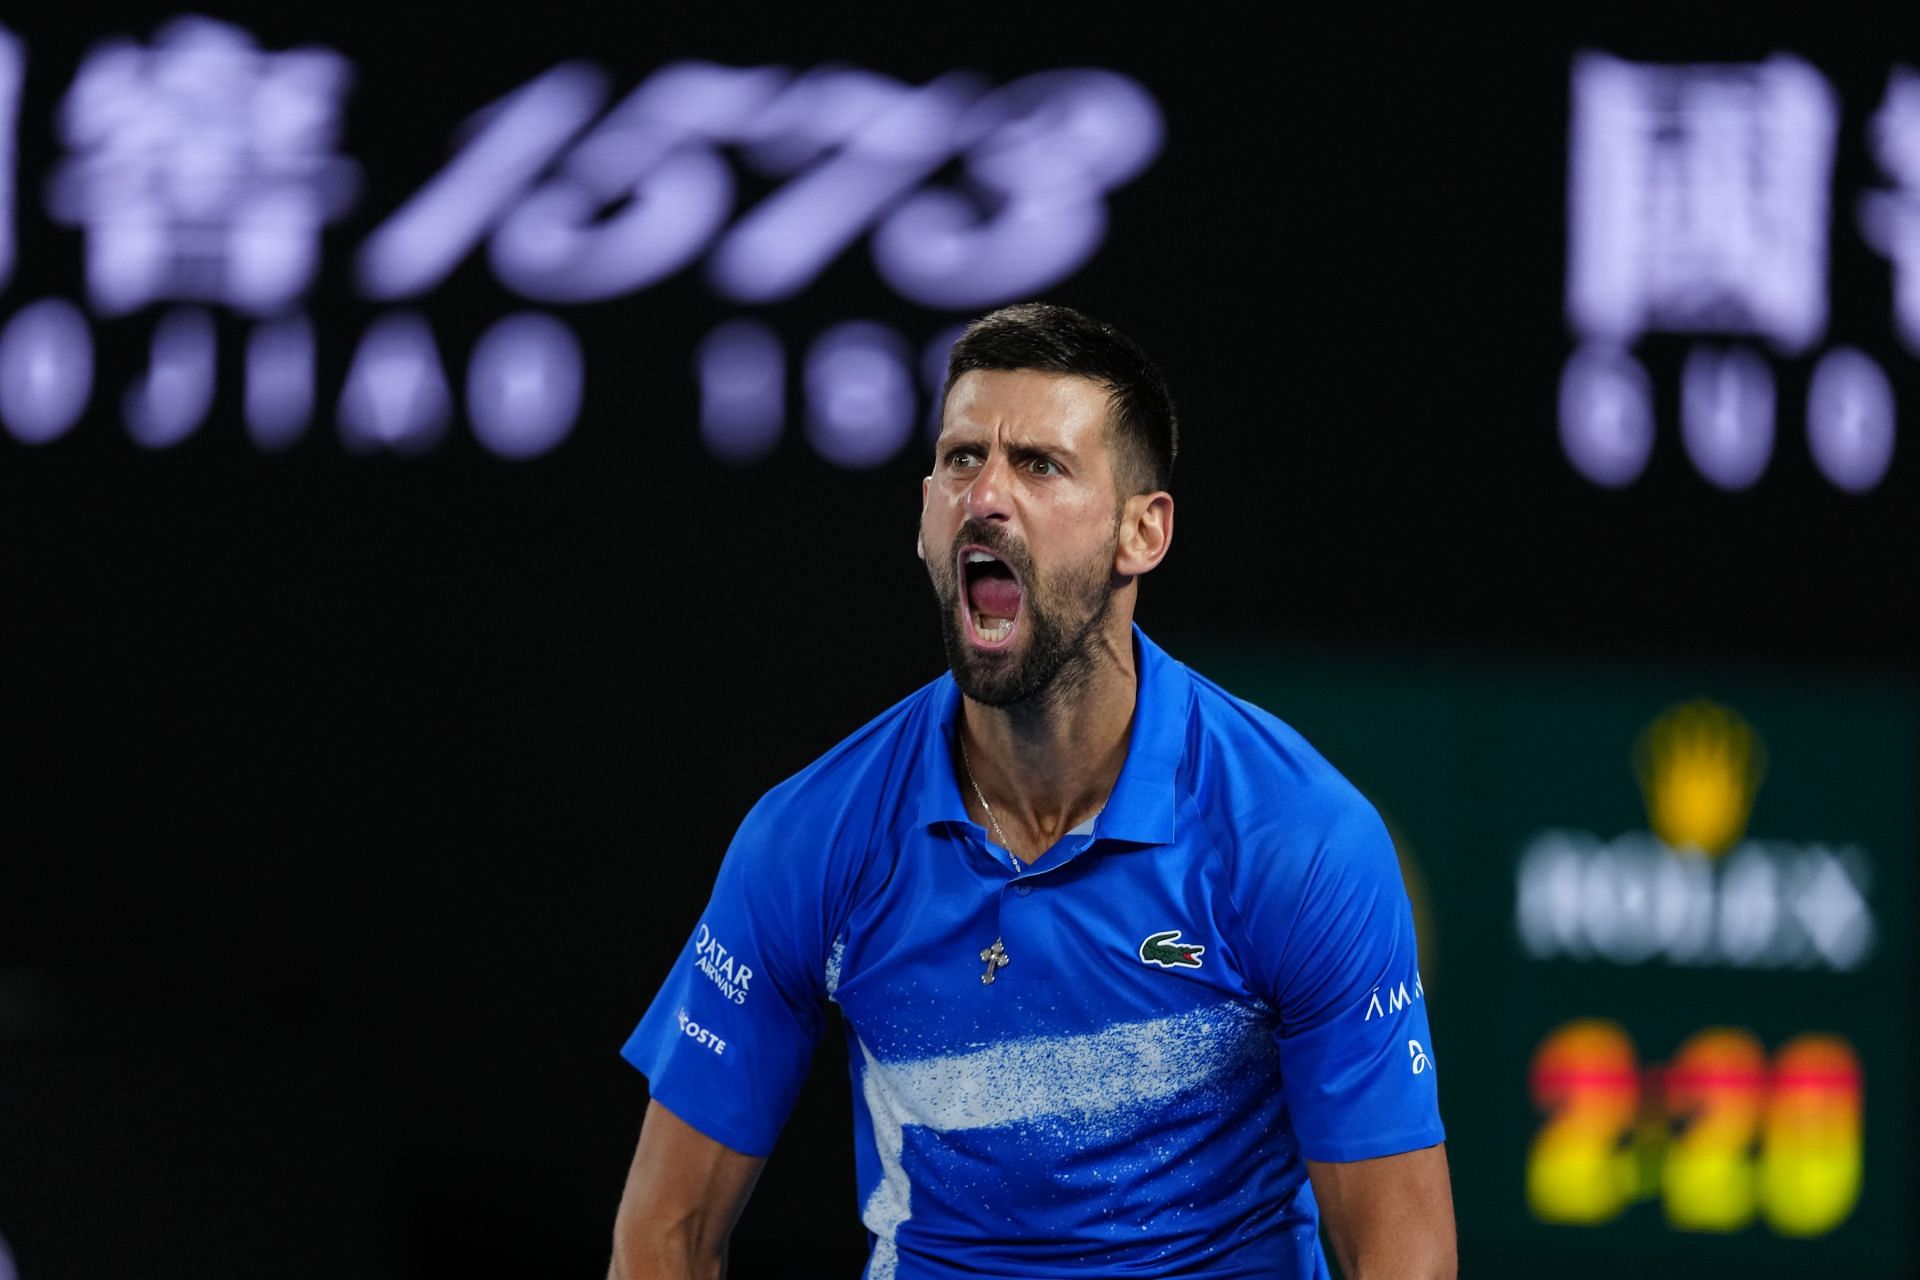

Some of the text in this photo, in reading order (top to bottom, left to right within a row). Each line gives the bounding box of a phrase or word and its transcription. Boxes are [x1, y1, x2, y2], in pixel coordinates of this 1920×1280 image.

[358, 62, 1164, 307] 1573
[695, 956, 748, 1005] AIRWAYS
[696, 923, 753, 991] QATAR
